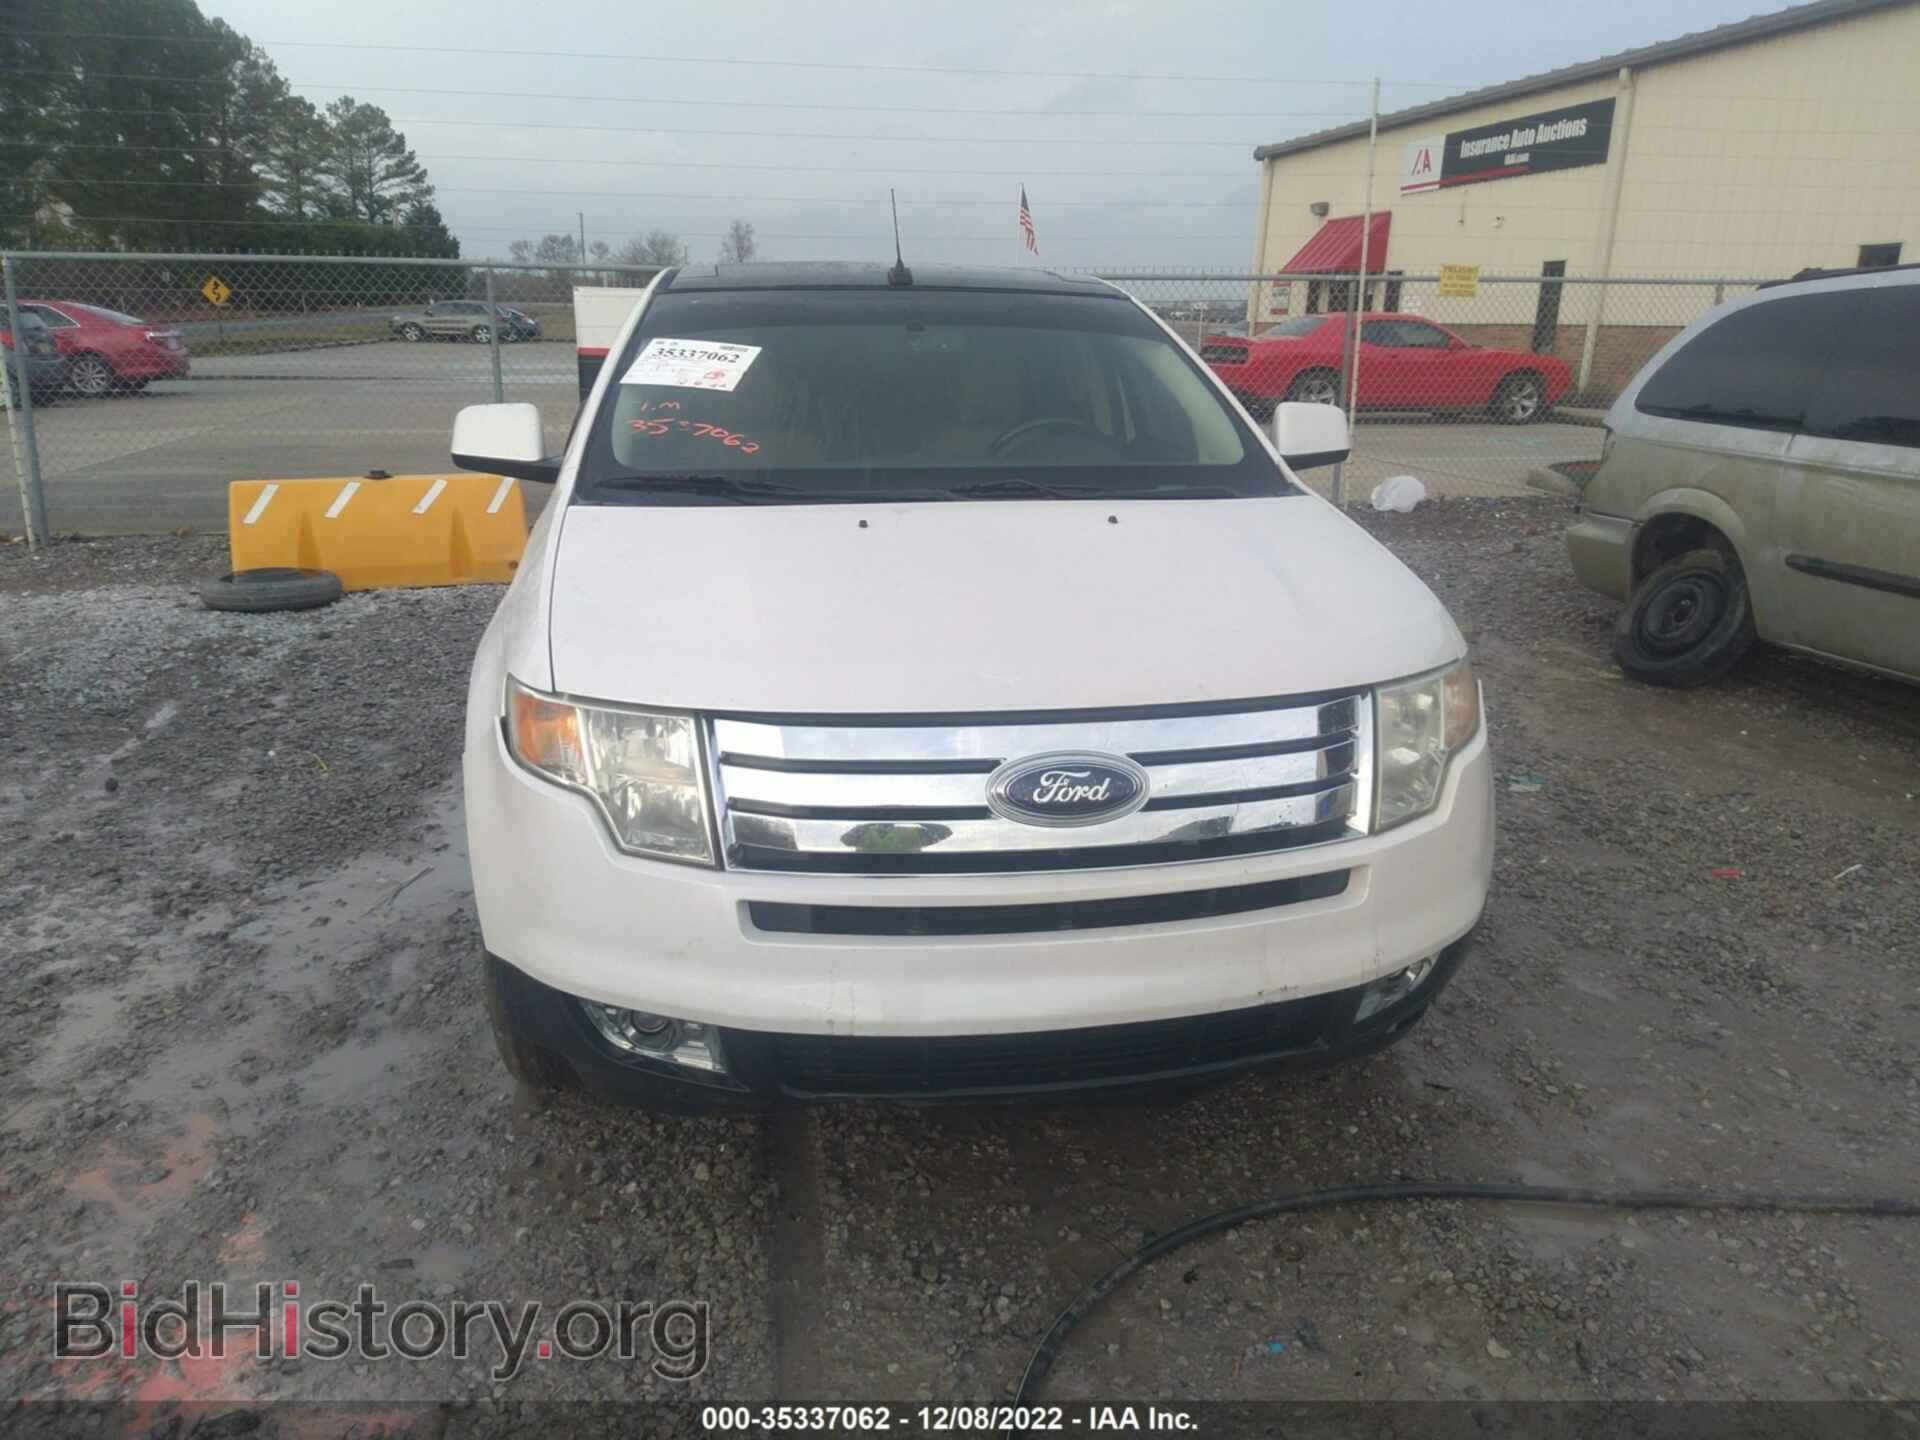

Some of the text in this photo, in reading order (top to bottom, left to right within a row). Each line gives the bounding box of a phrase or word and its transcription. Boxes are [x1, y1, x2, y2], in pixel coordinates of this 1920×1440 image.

[1459, 134, 1510, 159] Insurance
[1510, 127, 1535, 149] Auto
[1535, 117, 1588, 144] Auctions
[656, 347, 740, 364] 35337062
[1033, 770, 1111, 803] Ford
